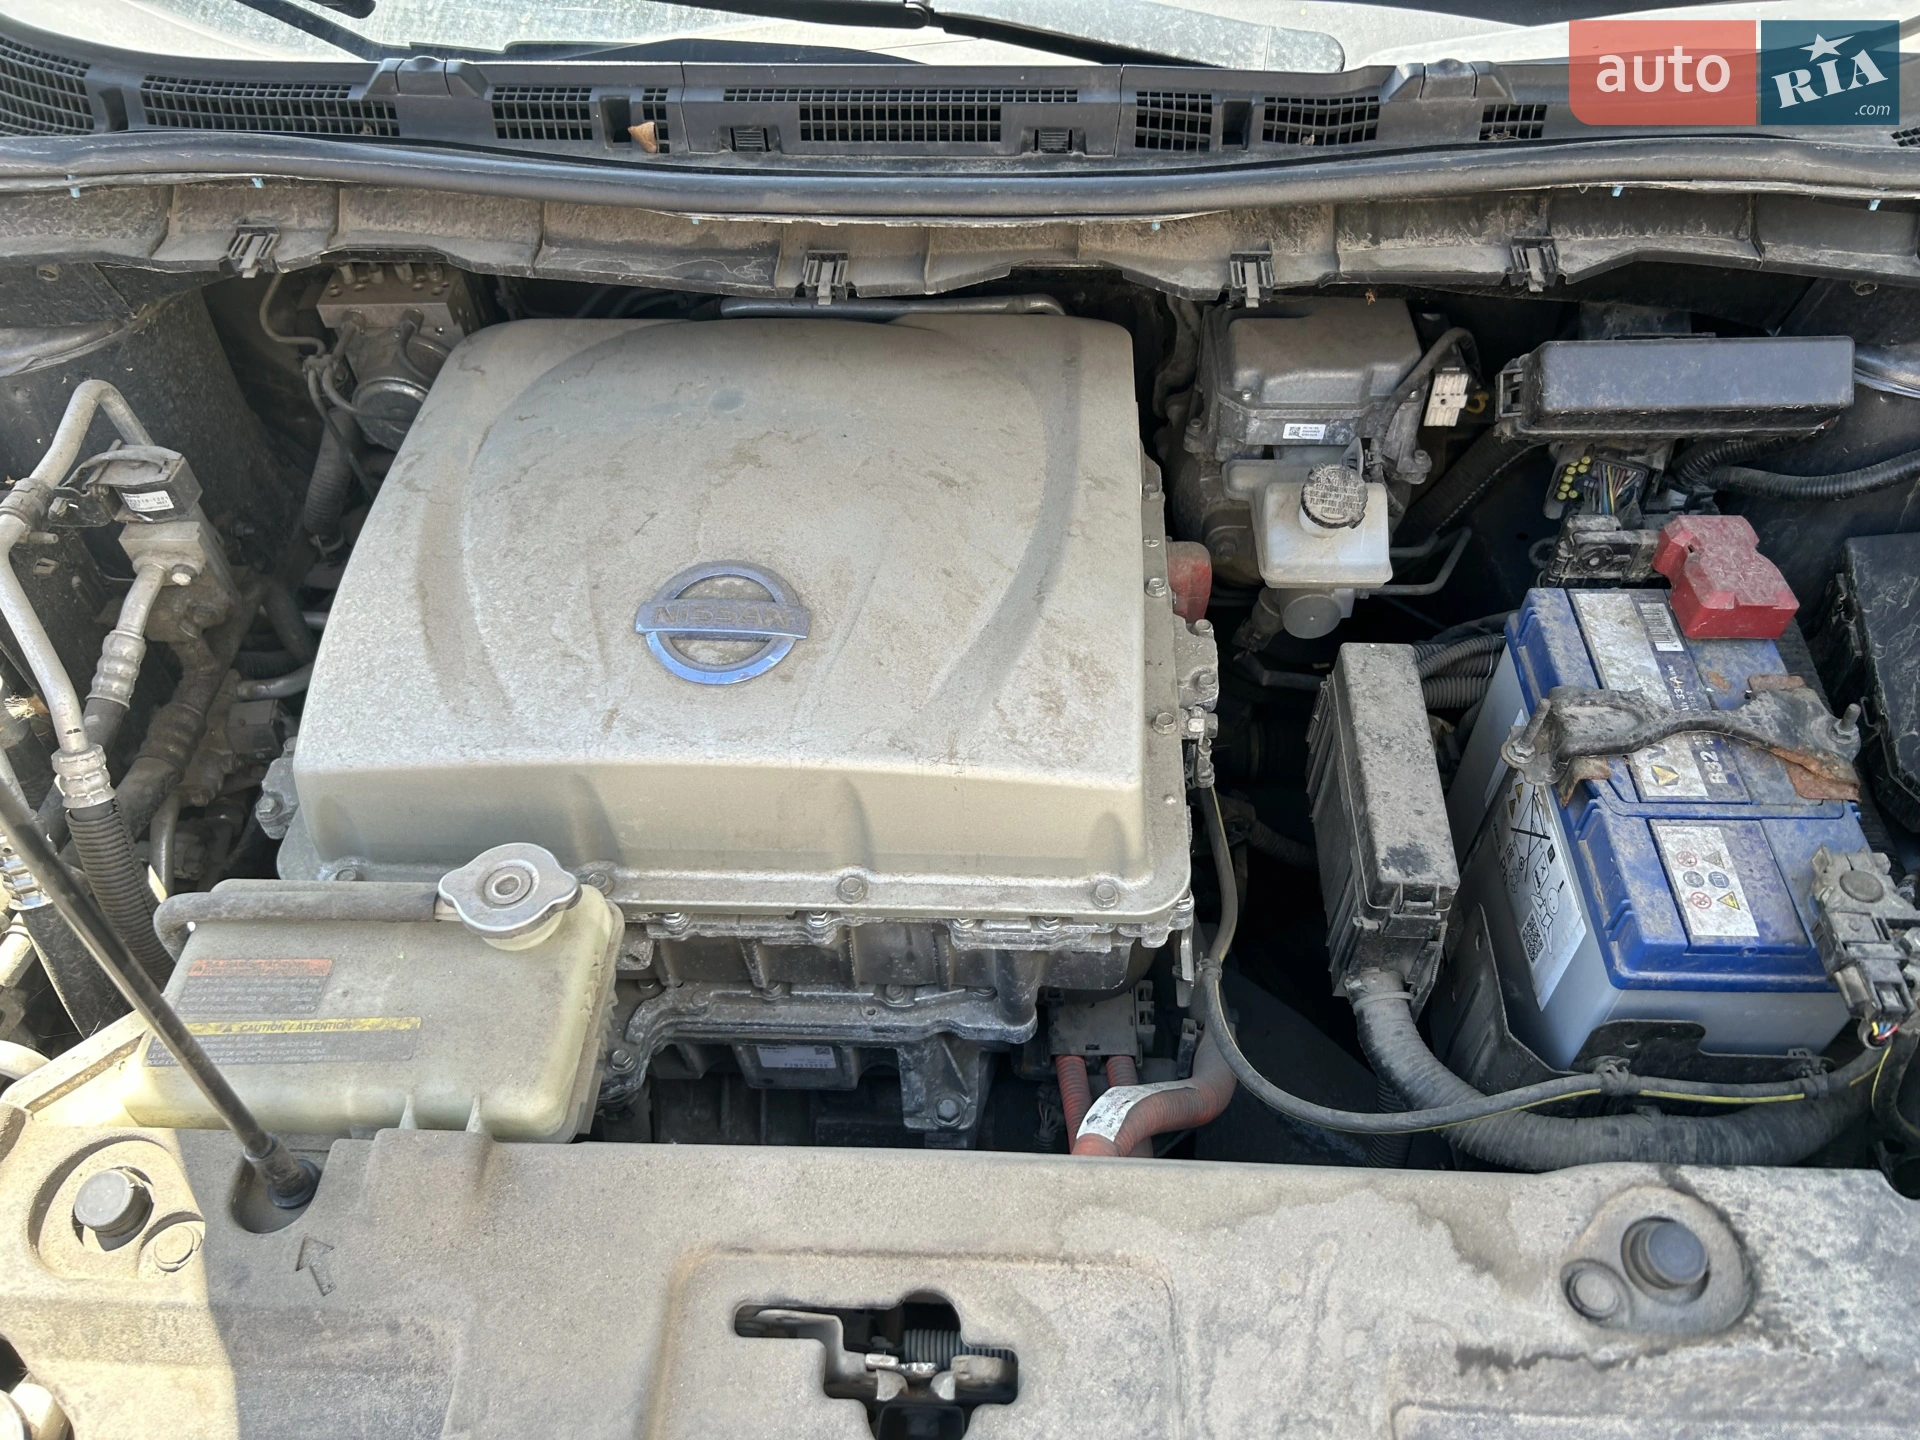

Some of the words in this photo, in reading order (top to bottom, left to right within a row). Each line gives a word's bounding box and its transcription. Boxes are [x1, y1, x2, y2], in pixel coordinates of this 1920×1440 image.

[653, 604, 789, 628] NISSAN
[1699, 750, 1727, 784] B32
[240, 1023, 285, 1032] CAUTION
[296, 1021, 352, 1031] ATTENTION
